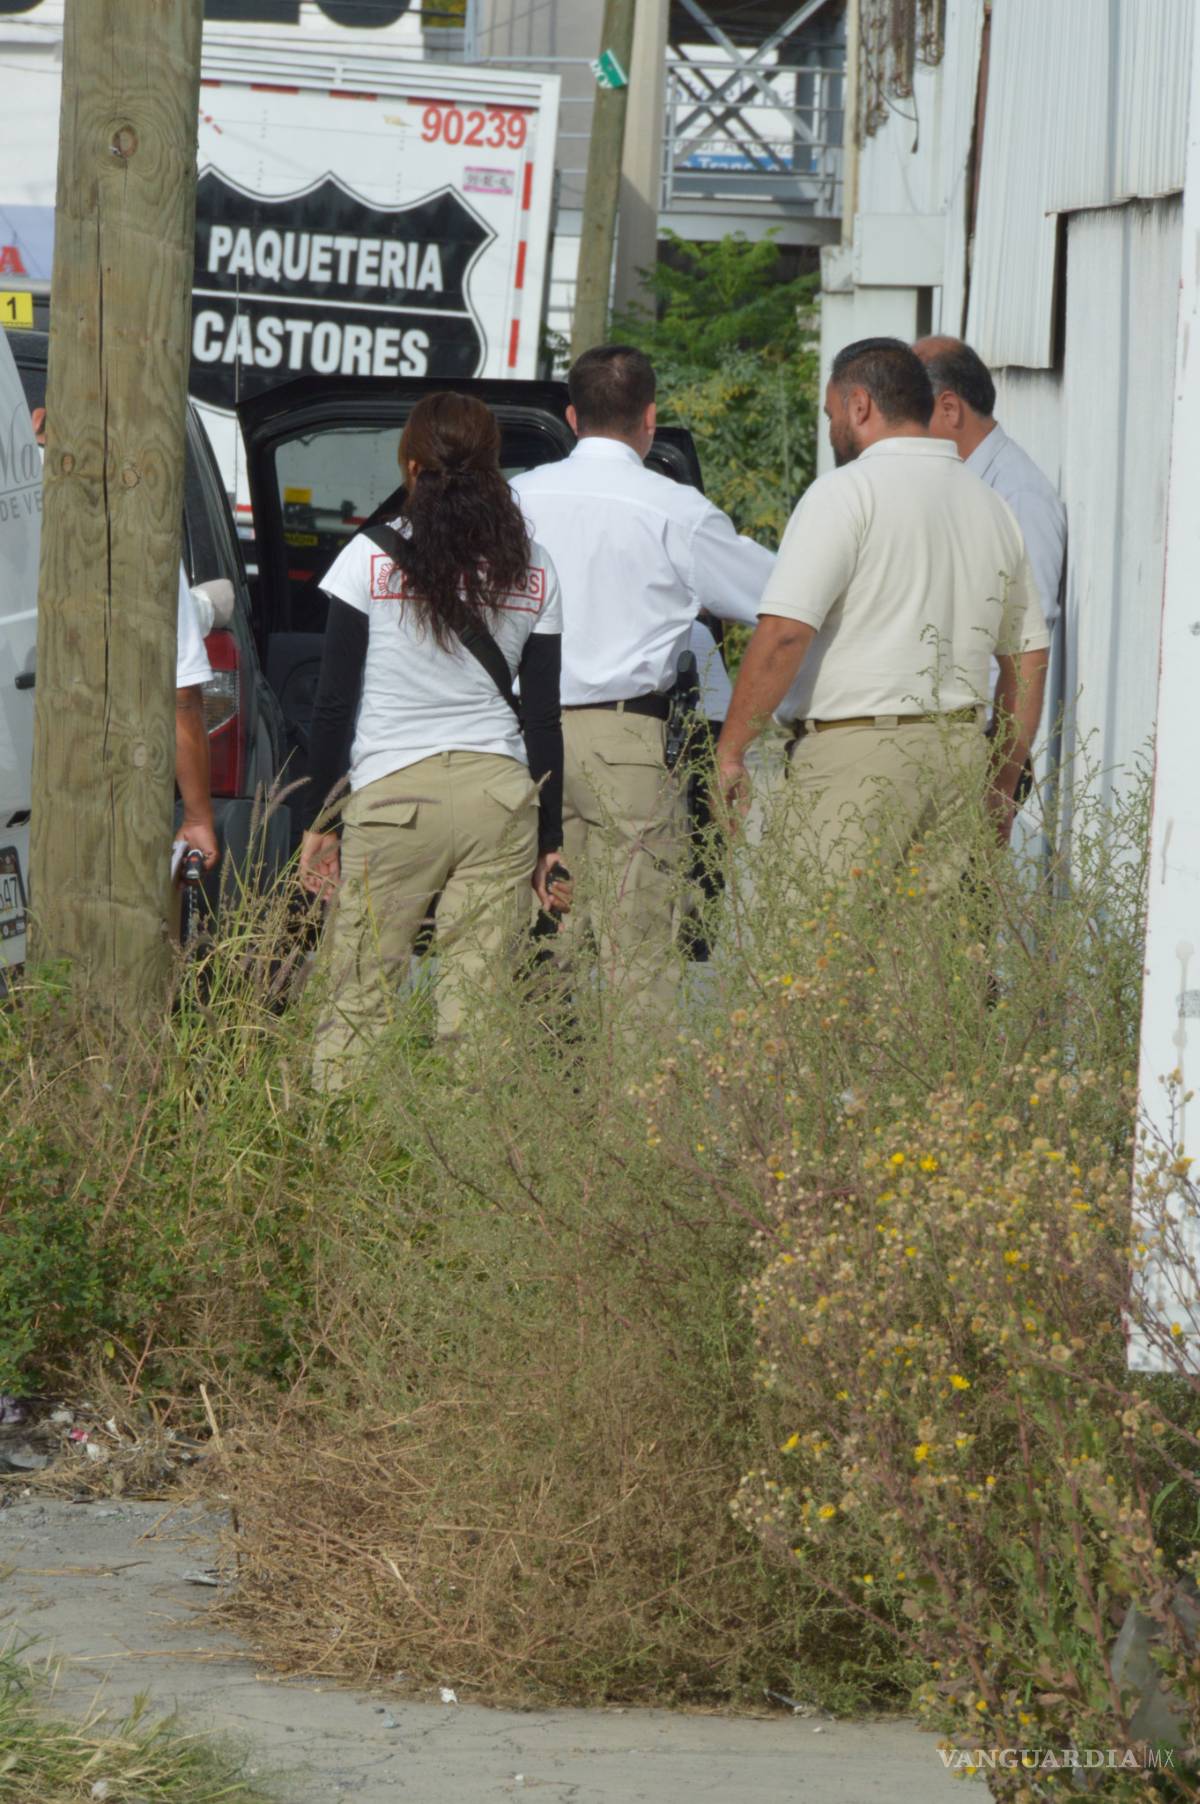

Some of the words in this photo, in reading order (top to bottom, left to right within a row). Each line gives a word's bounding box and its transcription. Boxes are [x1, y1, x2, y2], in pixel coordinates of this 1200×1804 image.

[421, 105, 527, 149] 90239
[207, 225, 444, 292] PAQUETERIA
[191, 310, 430, 378] CASTORES
